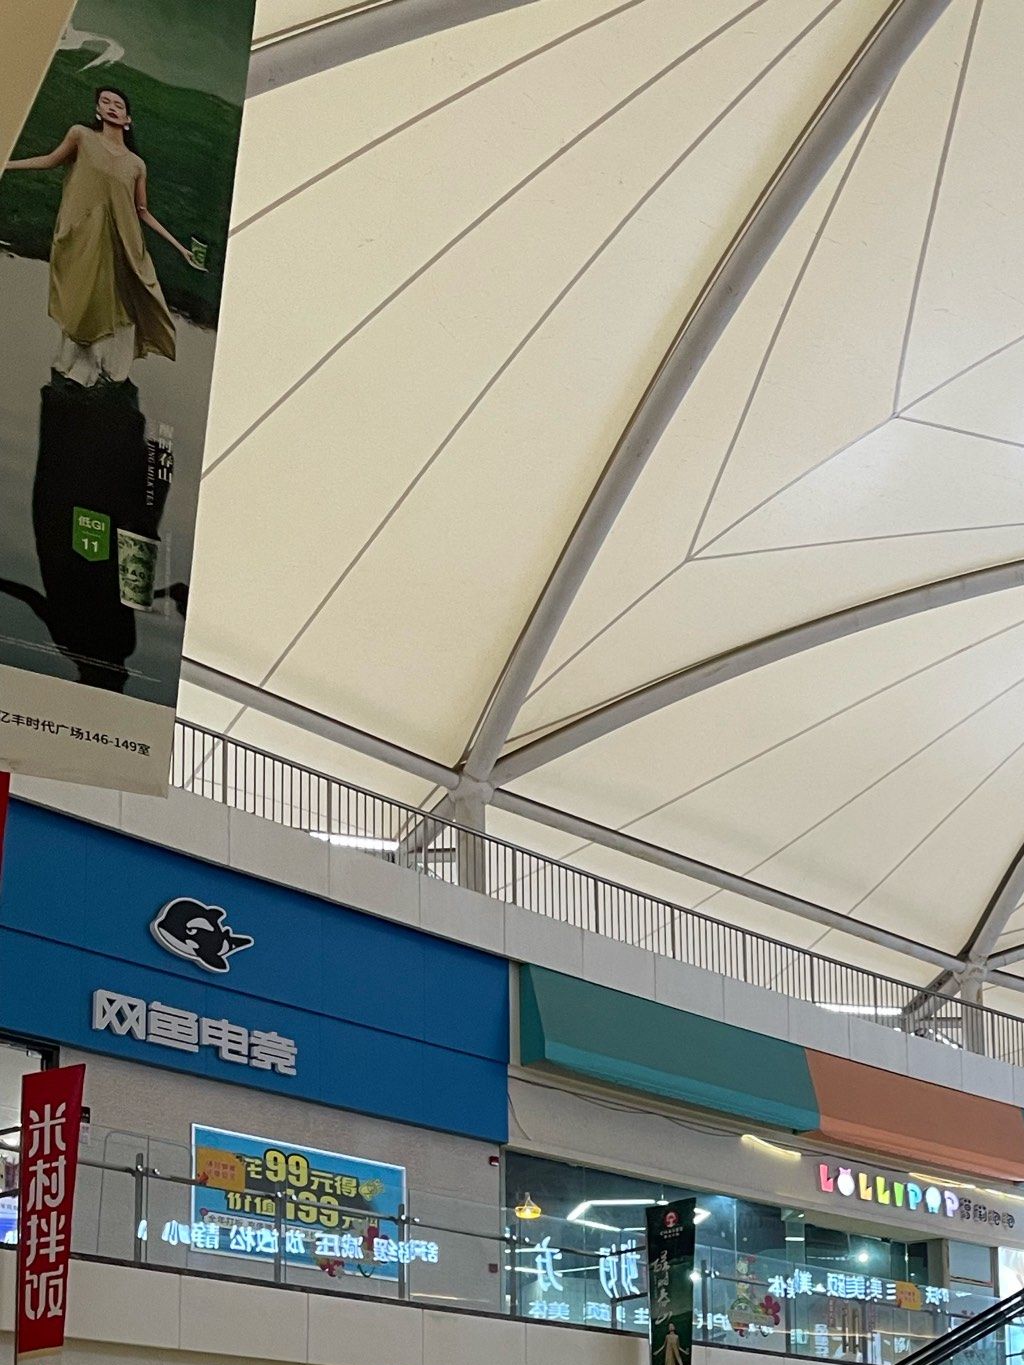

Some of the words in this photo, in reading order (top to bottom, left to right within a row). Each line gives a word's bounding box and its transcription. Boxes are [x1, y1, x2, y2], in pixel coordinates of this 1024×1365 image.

[81, 537, 99, 553] 11
[92, 988, 298, 1076] 网鱼电竞
[25, 1101, 67, 1321] 米村拌饭
[818, 1163, 960, 1218] LOLLIPOP
